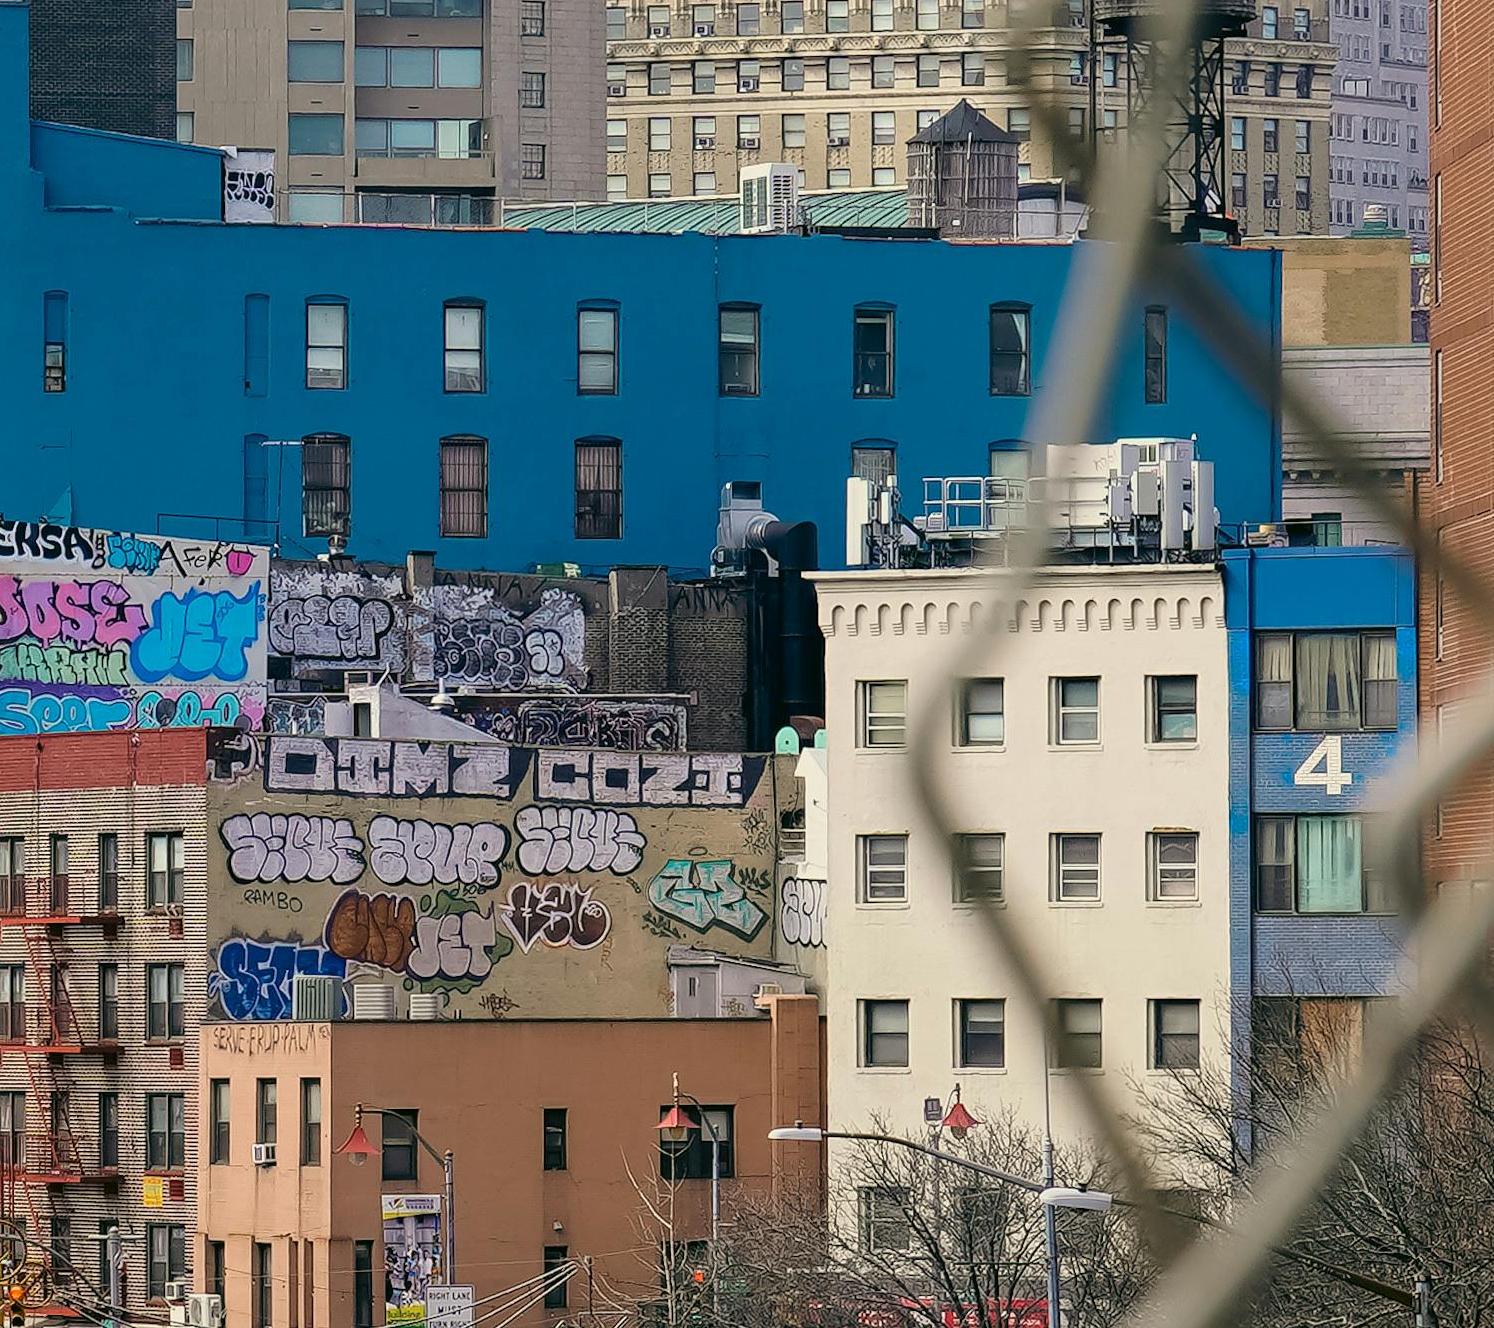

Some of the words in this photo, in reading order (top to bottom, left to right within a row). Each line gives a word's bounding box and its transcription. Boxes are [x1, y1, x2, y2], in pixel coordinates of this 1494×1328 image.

[1295, 735, 1353, 795] 4
[244, 889, 303, 914] RAMBO
[407, 901, 498, 981] JET
[429, 1291, 451, 1300] RIGHT
[452, 1291, 471, 1300] LANE
[429, 1321, 448, 1328] TURN
